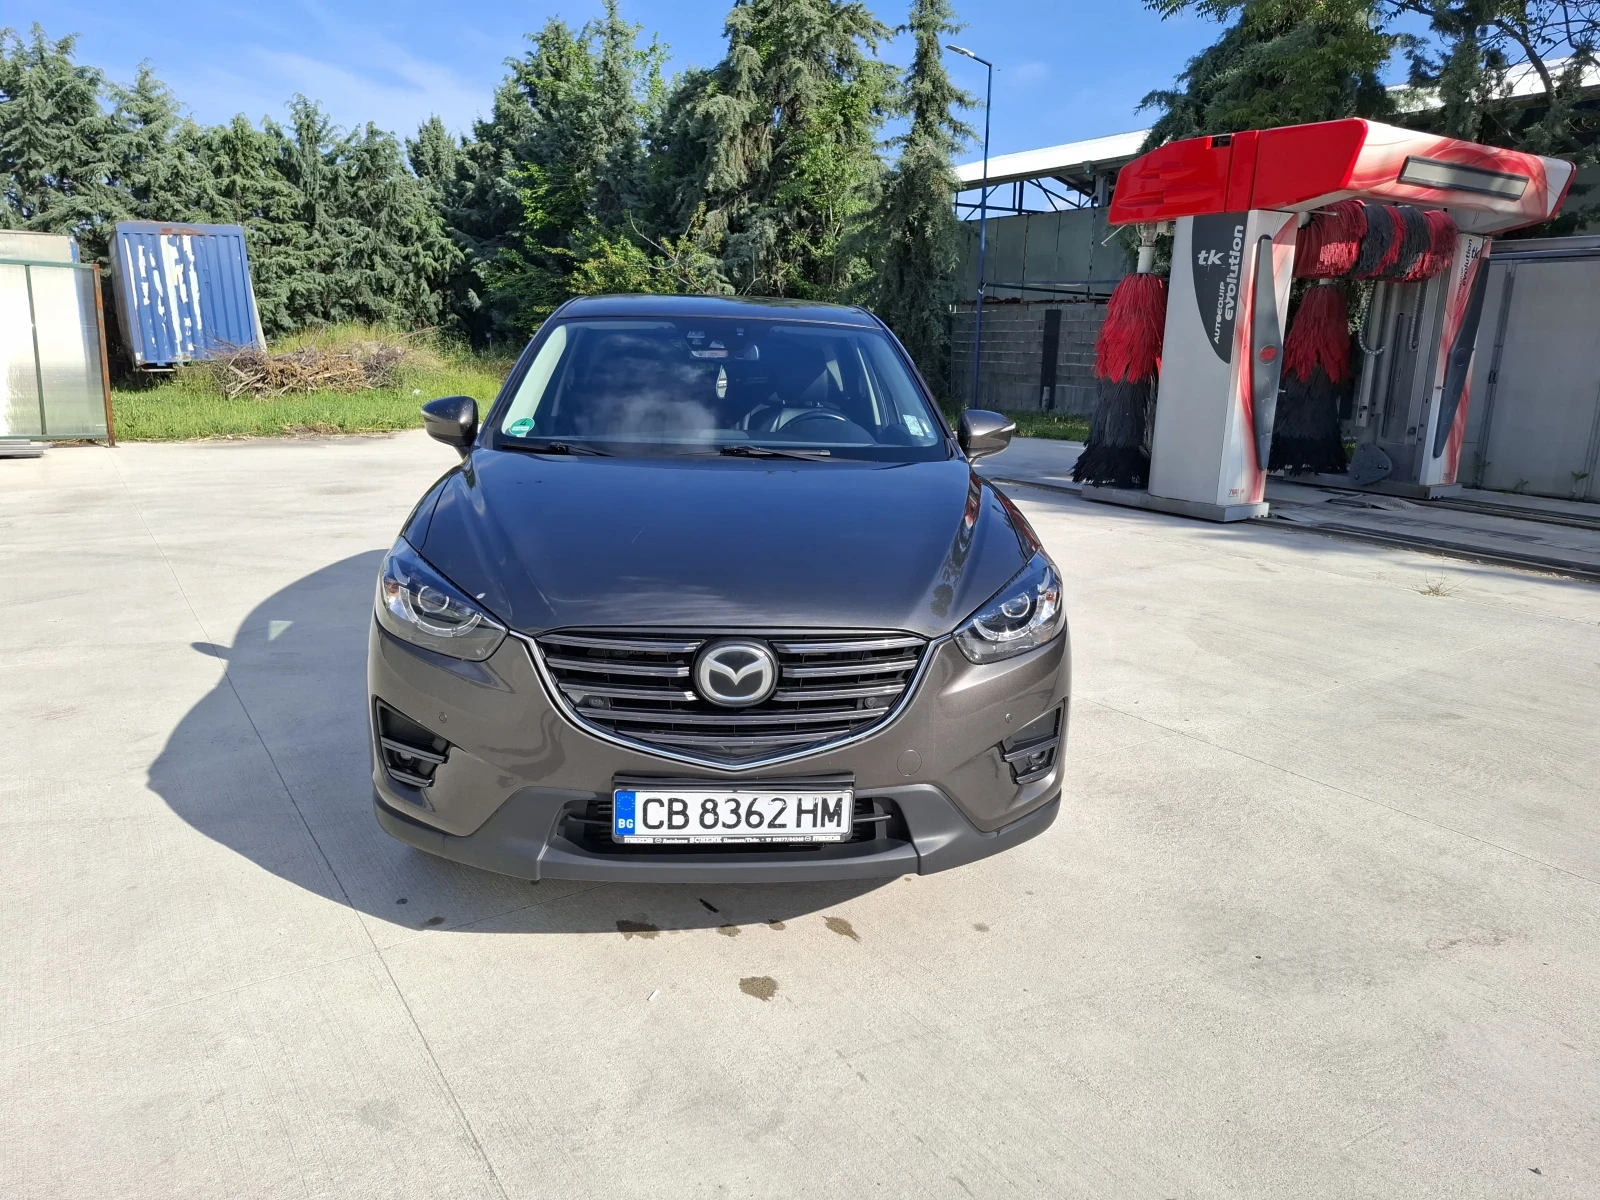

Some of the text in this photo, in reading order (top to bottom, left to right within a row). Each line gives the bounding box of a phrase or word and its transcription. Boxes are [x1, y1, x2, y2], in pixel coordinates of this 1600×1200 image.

[1198, 249, 1225, 265] tk
[1224, 225, 1244, 321] evolution
[618, 818, 634, 829] BG
[642, 797, 843, 829] CB 8362 HM
